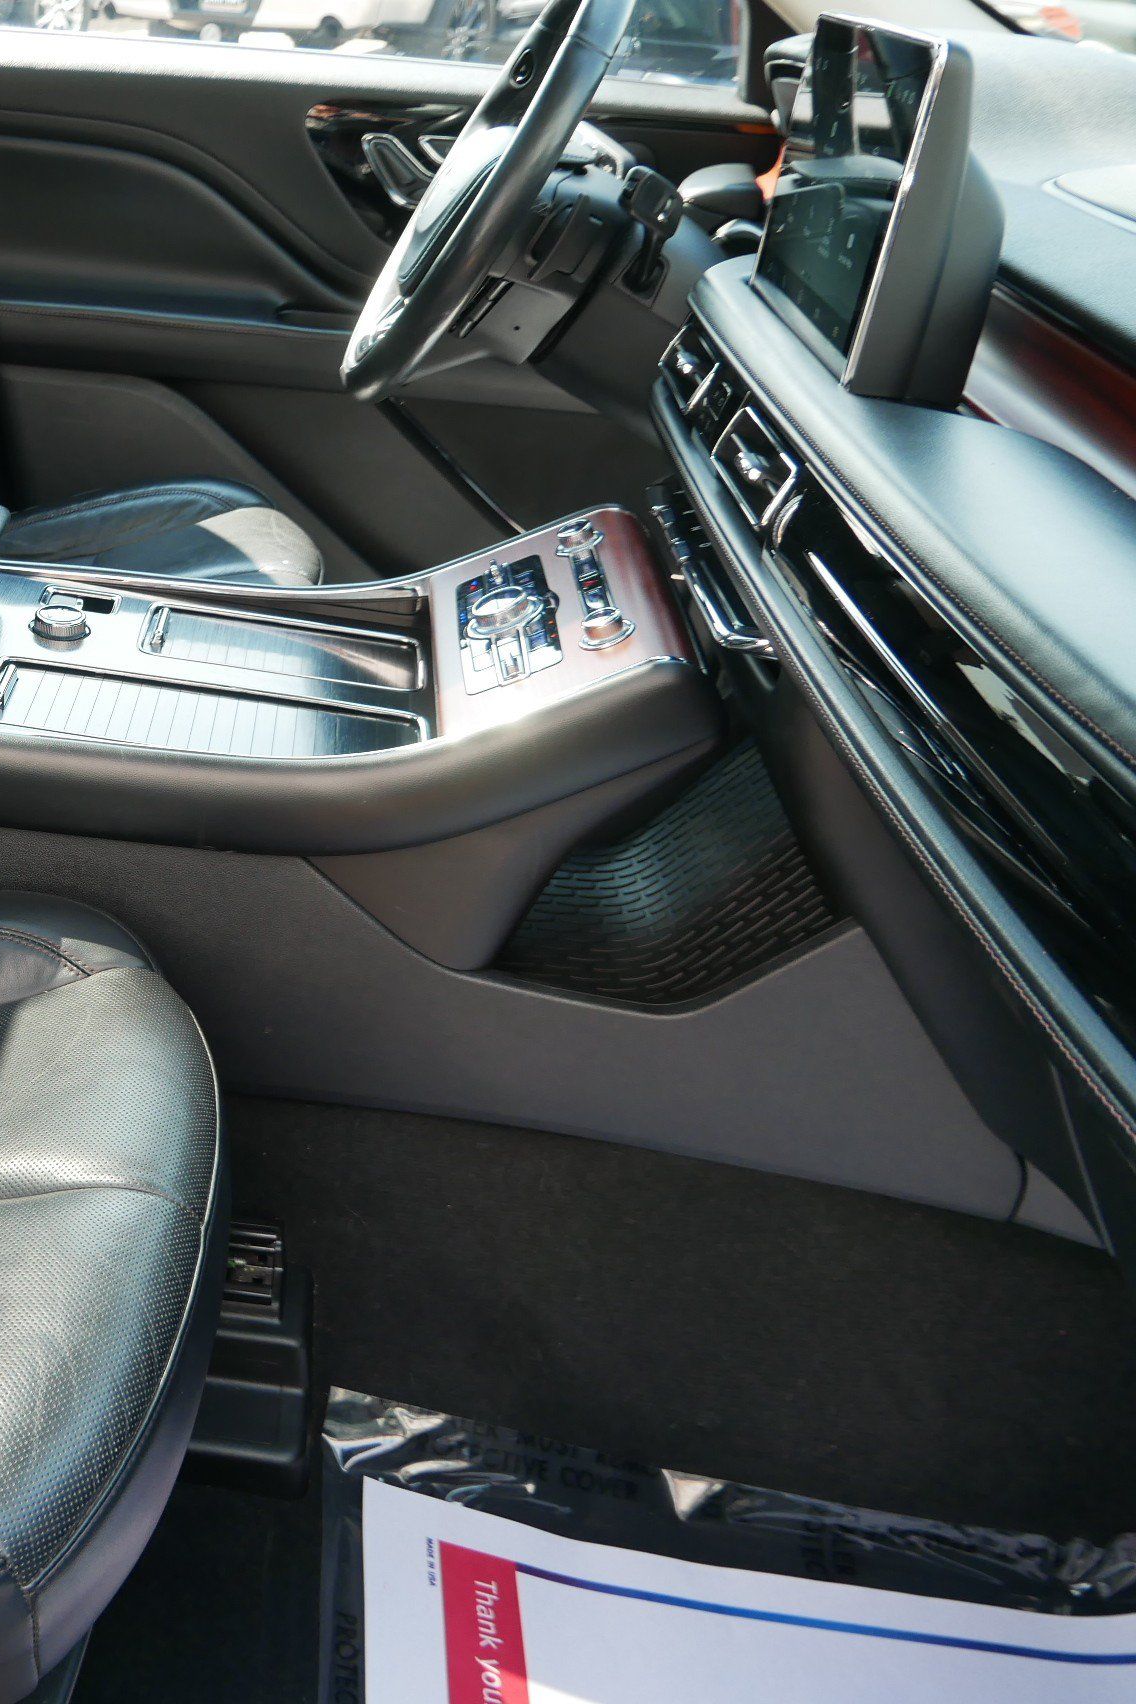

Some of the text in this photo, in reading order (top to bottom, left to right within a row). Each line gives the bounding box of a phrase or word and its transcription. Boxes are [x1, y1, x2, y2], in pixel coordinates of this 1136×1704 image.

[426, 1537, 436, 1558] MADE
[427, 1571, 436, 1586] USA
[473, 1580, 506, 1649] Thank
